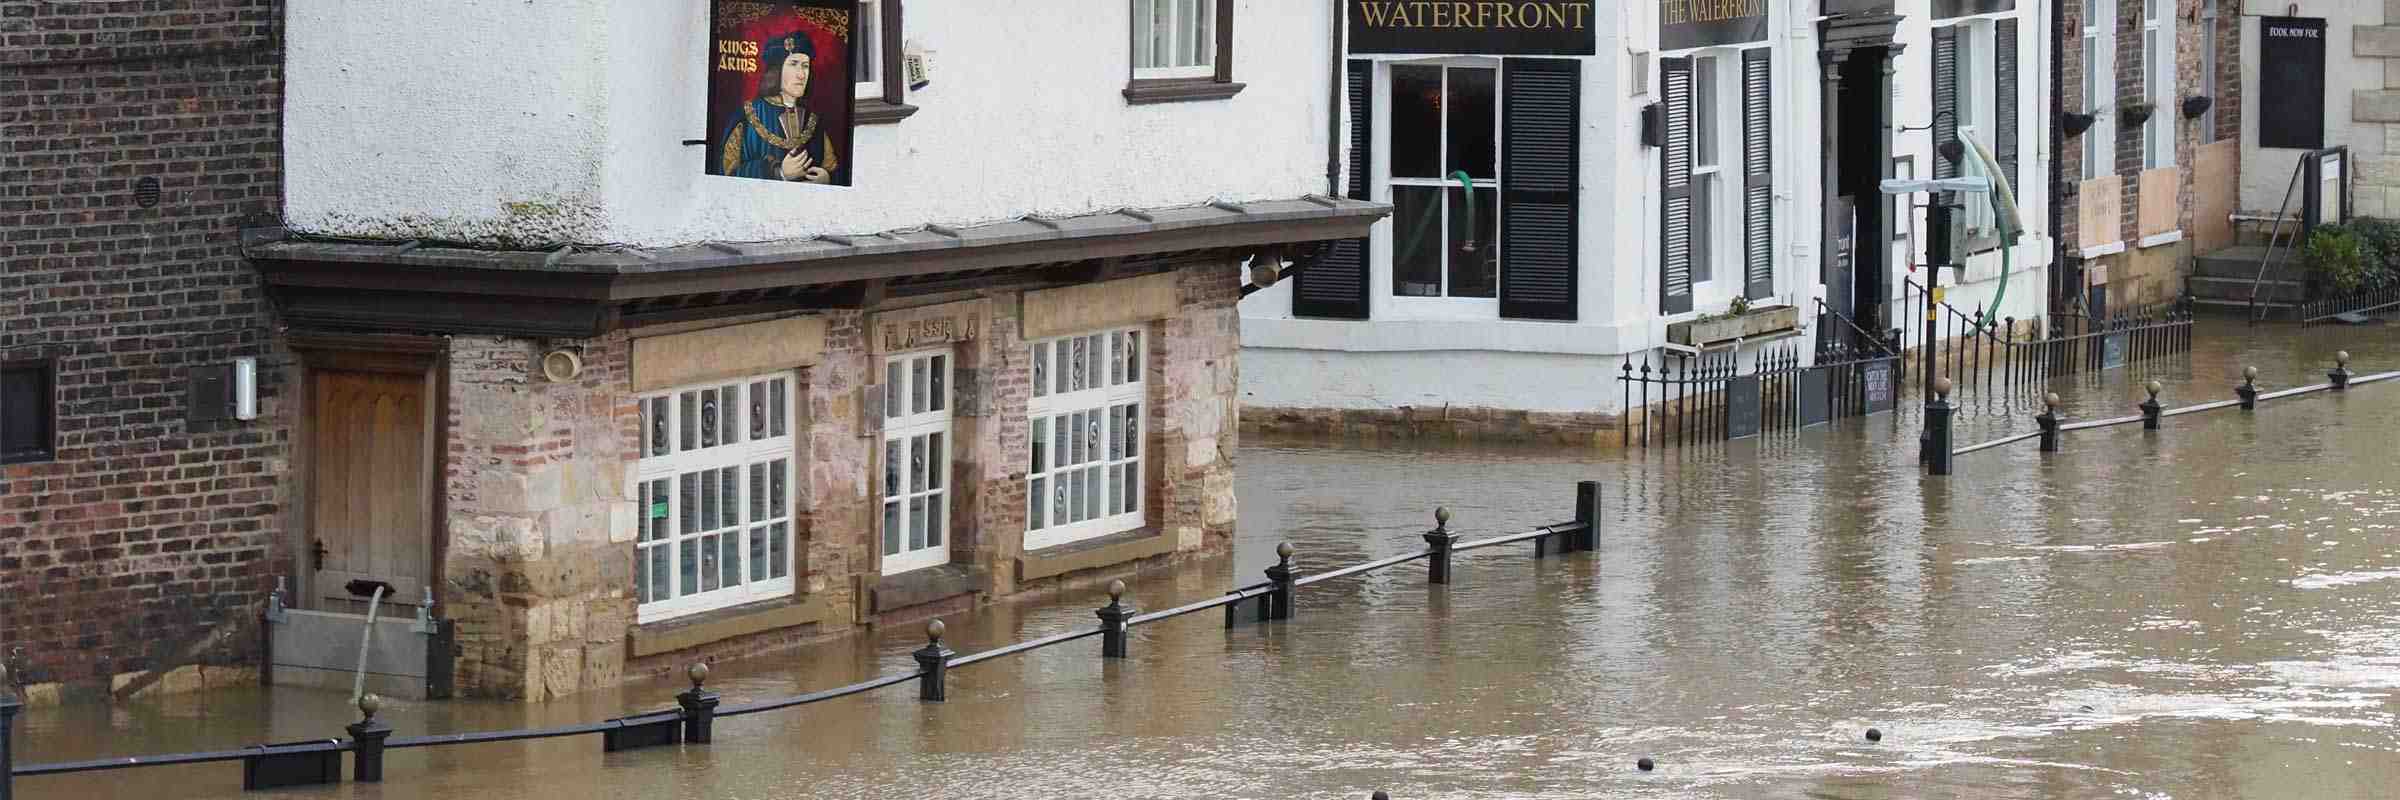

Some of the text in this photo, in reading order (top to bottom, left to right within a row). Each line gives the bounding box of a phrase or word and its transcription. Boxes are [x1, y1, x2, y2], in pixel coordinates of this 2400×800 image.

[1360, 1, 1590, 29] WATERFRONT
[1664, 0, 1767, 25] THE WATERFRONT
[719, 39, 759, 57] KINGS
[718, 55, 758, 73] ARMS
